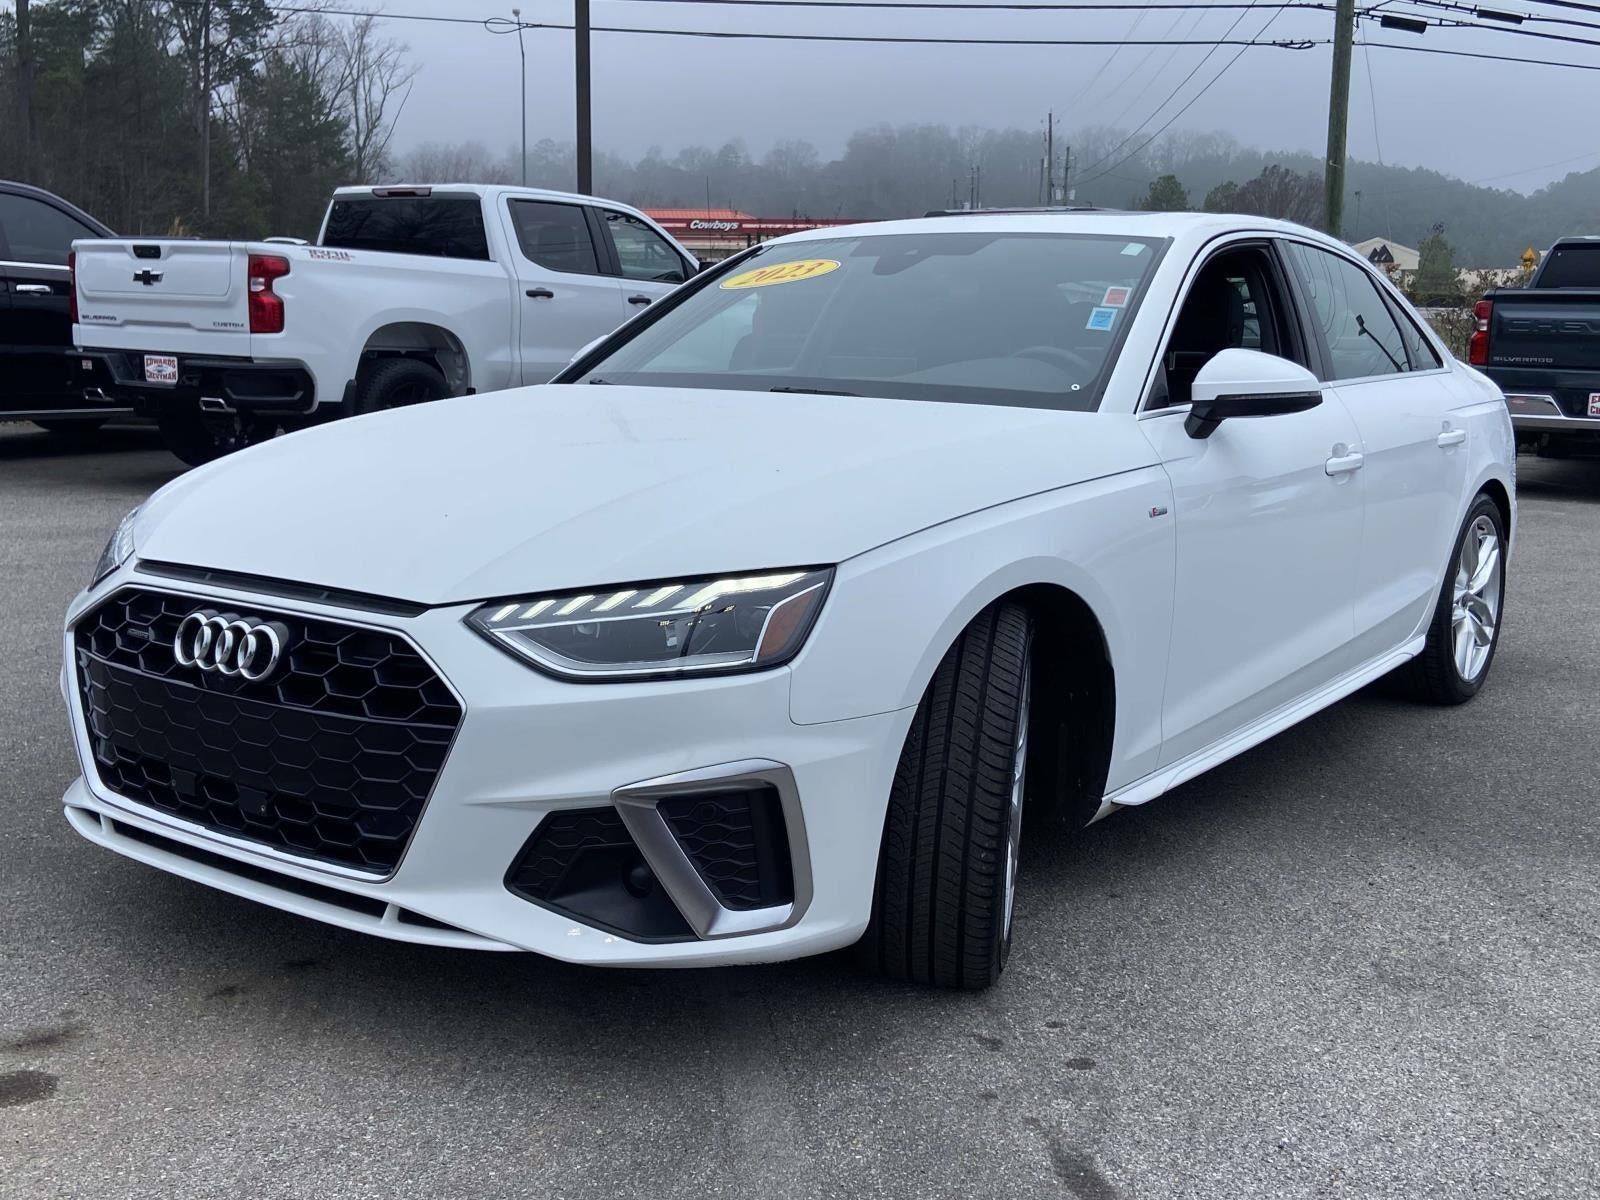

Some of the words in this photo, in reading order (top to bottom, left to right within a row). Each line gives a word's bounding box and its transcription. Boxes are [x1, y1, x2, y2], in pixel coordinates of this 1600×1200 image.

[690, 220, 739, 231] Cowboys
[734, 261, 827, 287] 2023
[145, 358, 176, 368] EDWARDS
[146, 370, 177, 380] CHEVYMAN
